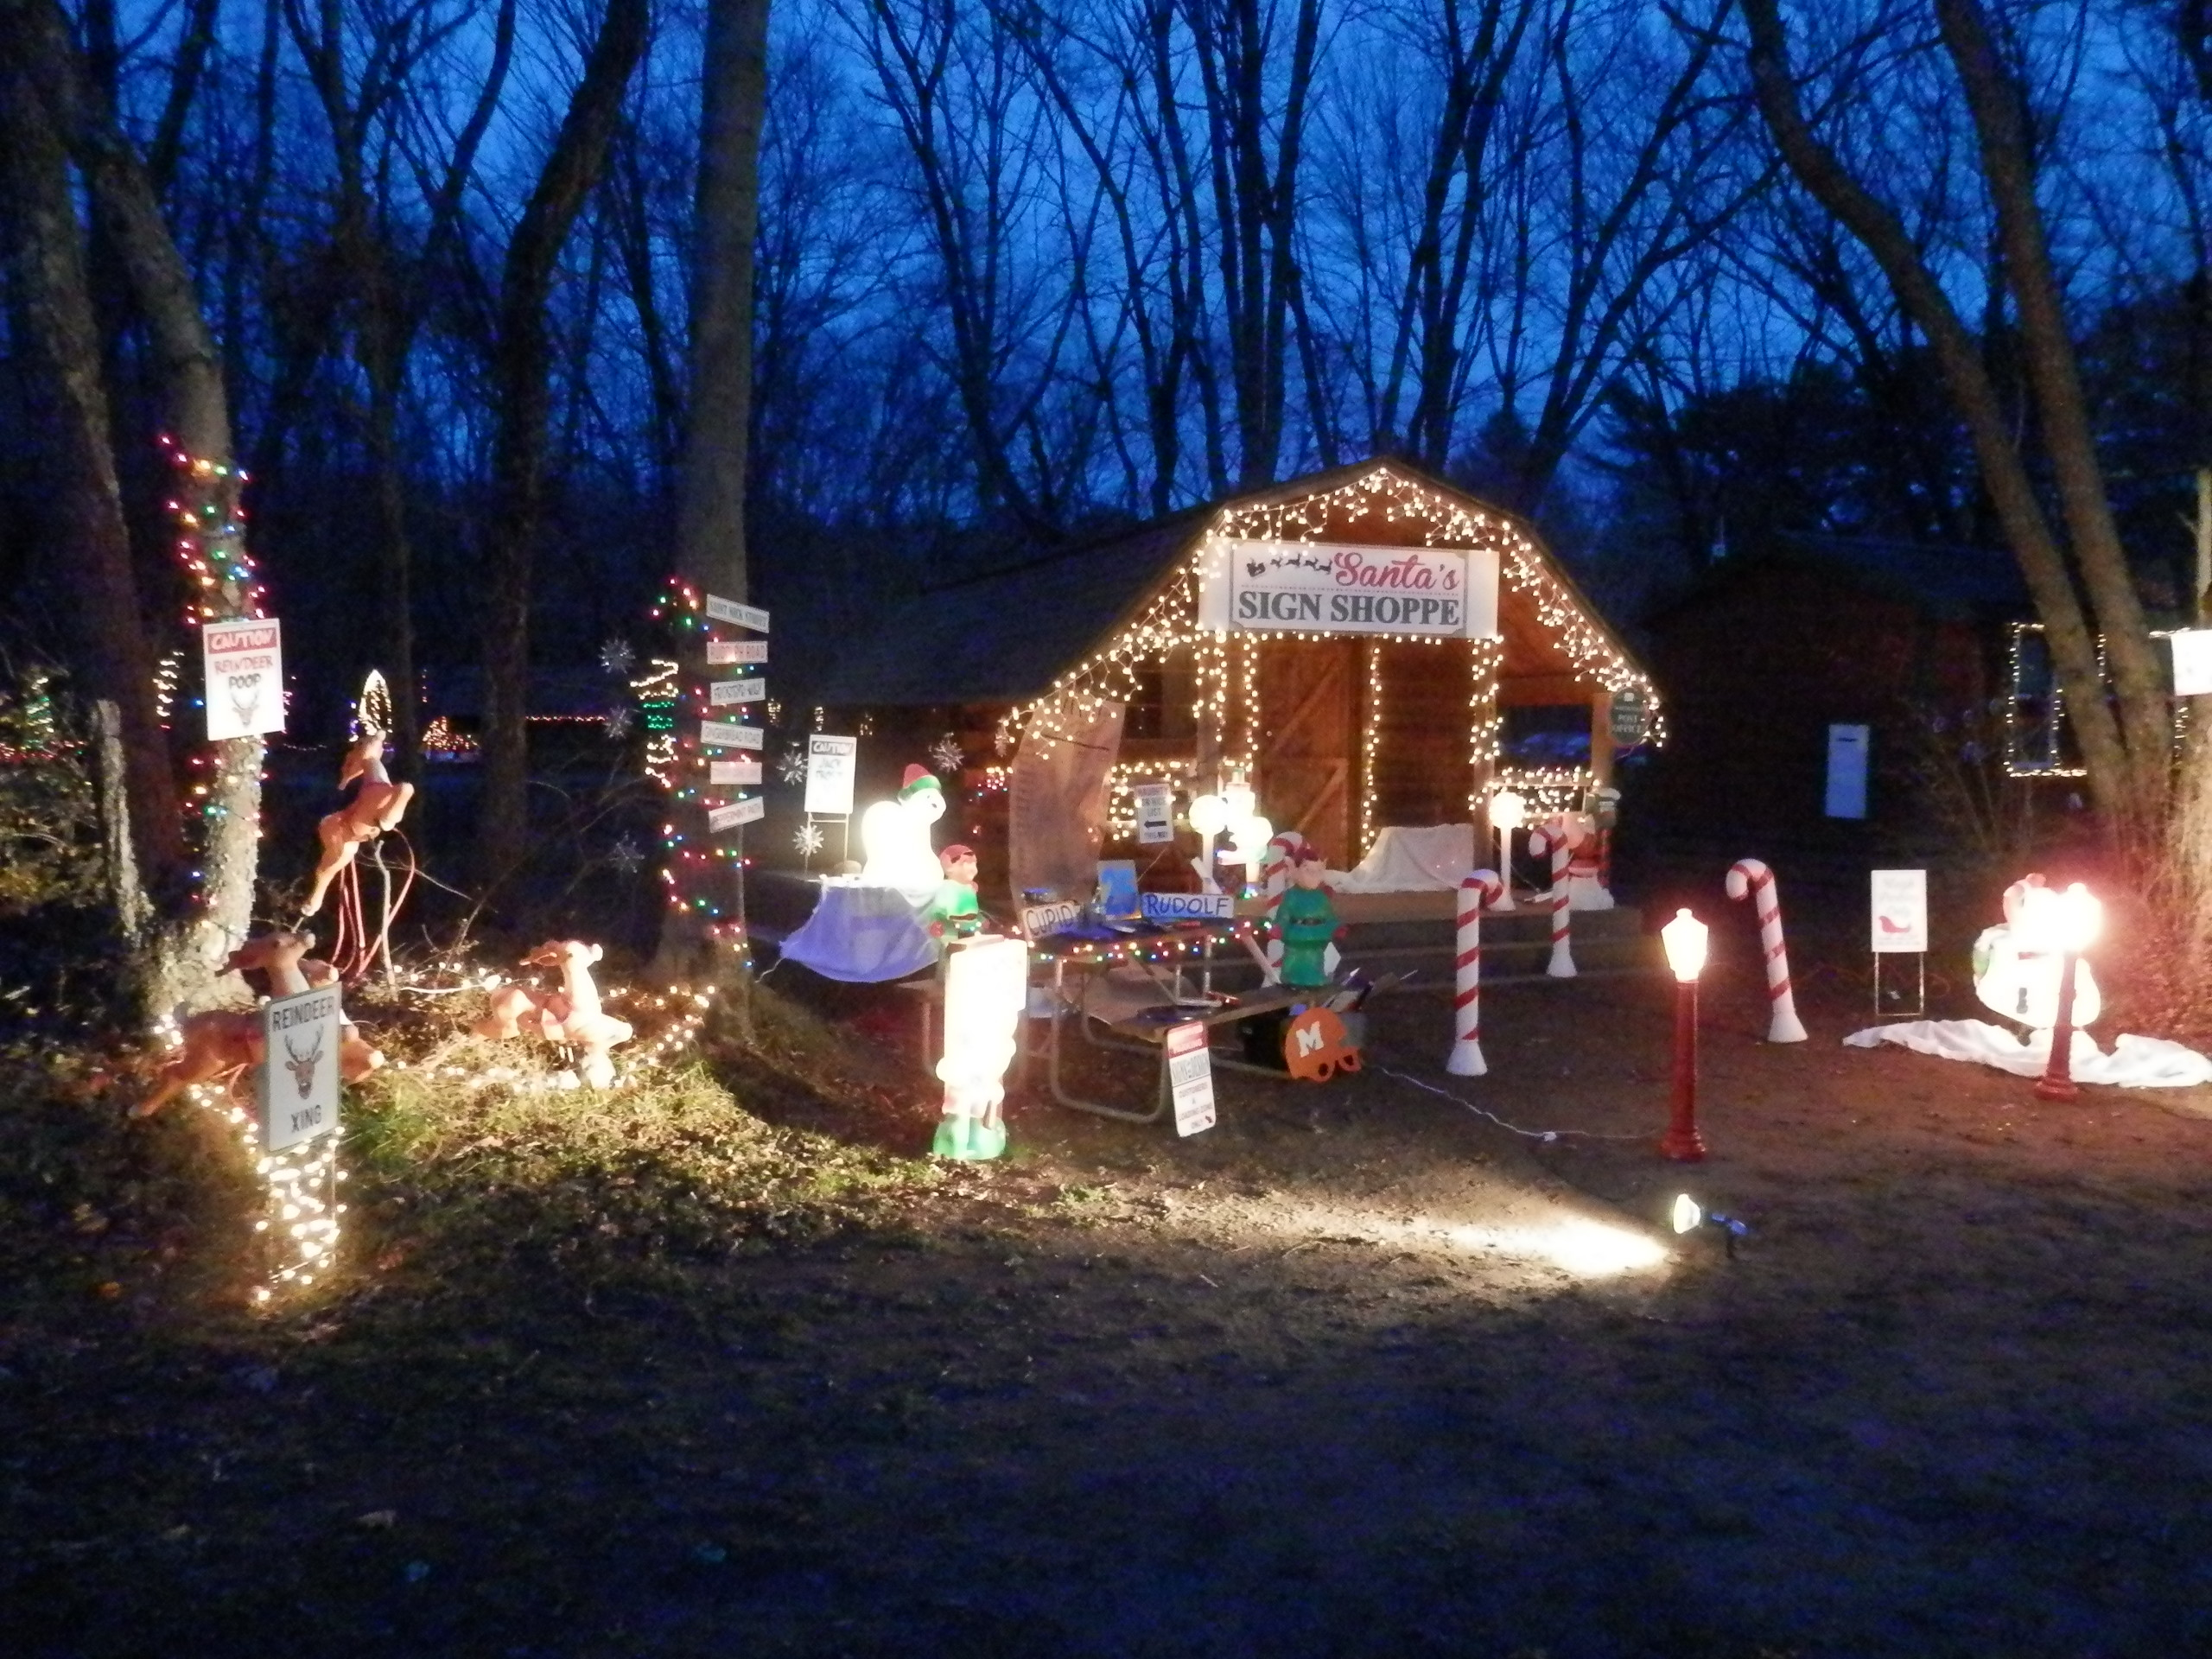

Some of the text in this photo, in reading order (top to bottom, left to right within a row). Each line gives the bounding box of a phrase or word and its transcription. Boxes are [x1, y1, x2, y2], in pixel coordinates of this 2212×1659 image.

[1334, 552, 1460, 591] Santa's
[1239, 590, 1459, 626] SIGN SHOPPE
[211, 629, 273, 651] CAUTION
[228, 673, 261, 690] POOP
[813, 741, 853, 754] CAUTION
[1146, 893, 1230, 916] RUDOLF
[1027, 905, 1074, 936] CUPID
[272, 996, 335, 1032] REINDEER
[1295, 1020, 1324, 1058] M
[290, 1104, 322, 1133] XING
